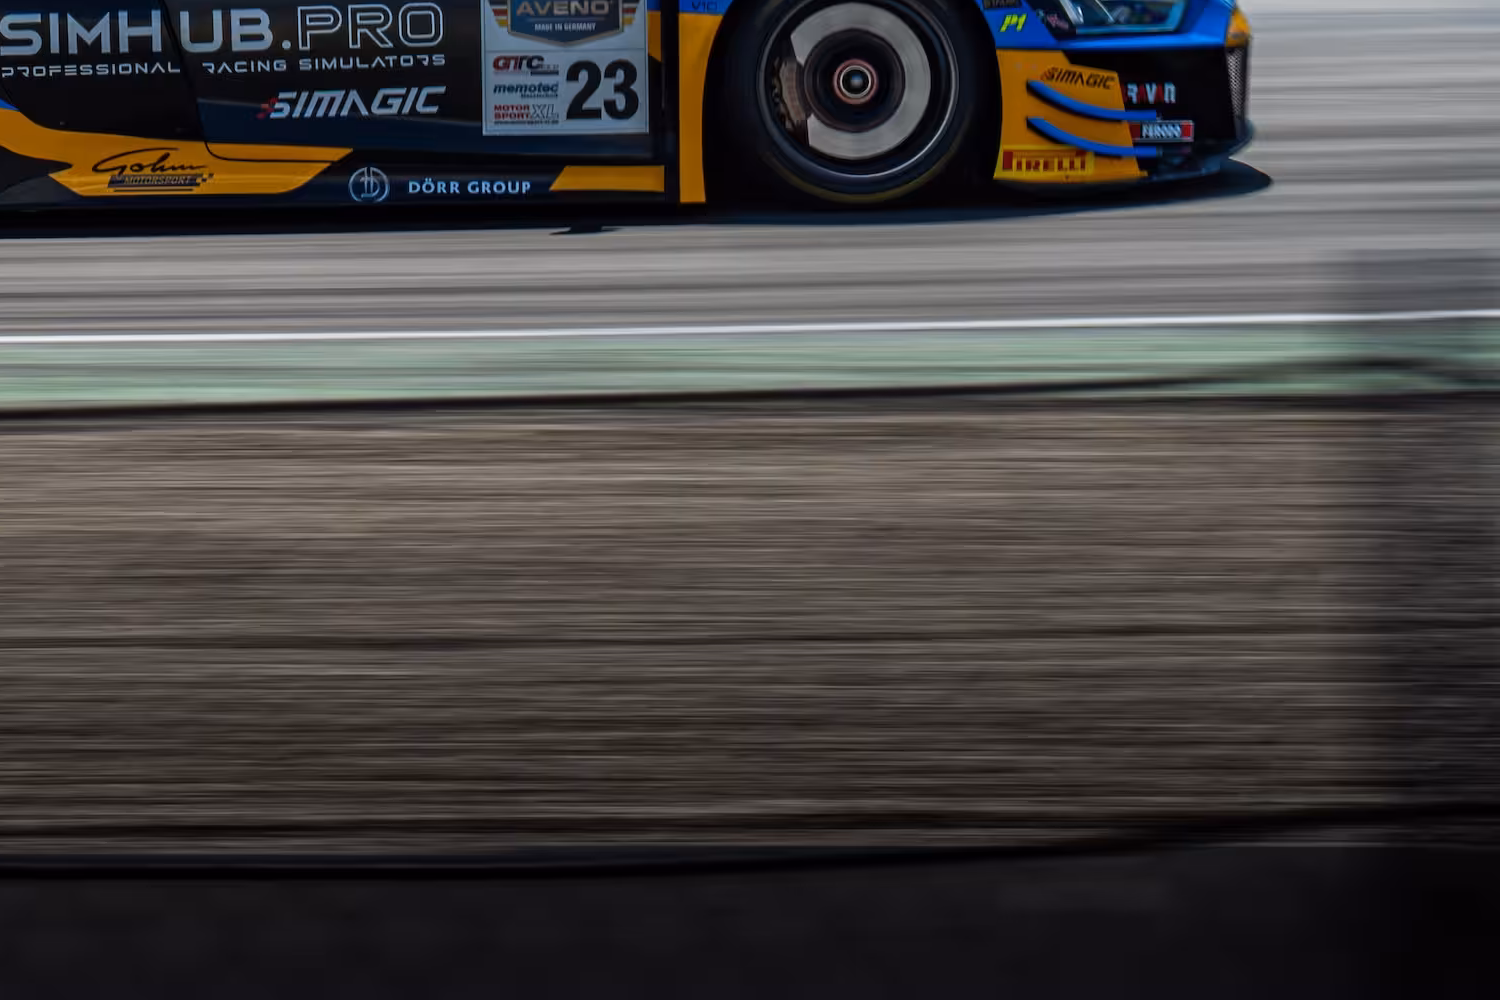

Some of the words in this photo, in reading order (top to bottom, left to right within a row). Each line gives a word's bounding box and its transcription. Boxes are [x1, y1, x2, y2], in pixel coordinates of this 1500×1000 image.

[516, 0, 609, 17] AVENO
[0, 2, 444, 56] SIMHUB.PRO
[564, 22, 596, 31] GERMANY
[2, 62, 181, 78] PROFESSIONAL
[202, 60, 287, 73] RACING
[299, 54, 445, 71] SIMULATORS
[566, 59, 639, 121] 23
[269, 86, 446, 119] SIMAGIC
[408, 178, 460, 194] DÖRR
[467, 181, 531, 194] GROUP
